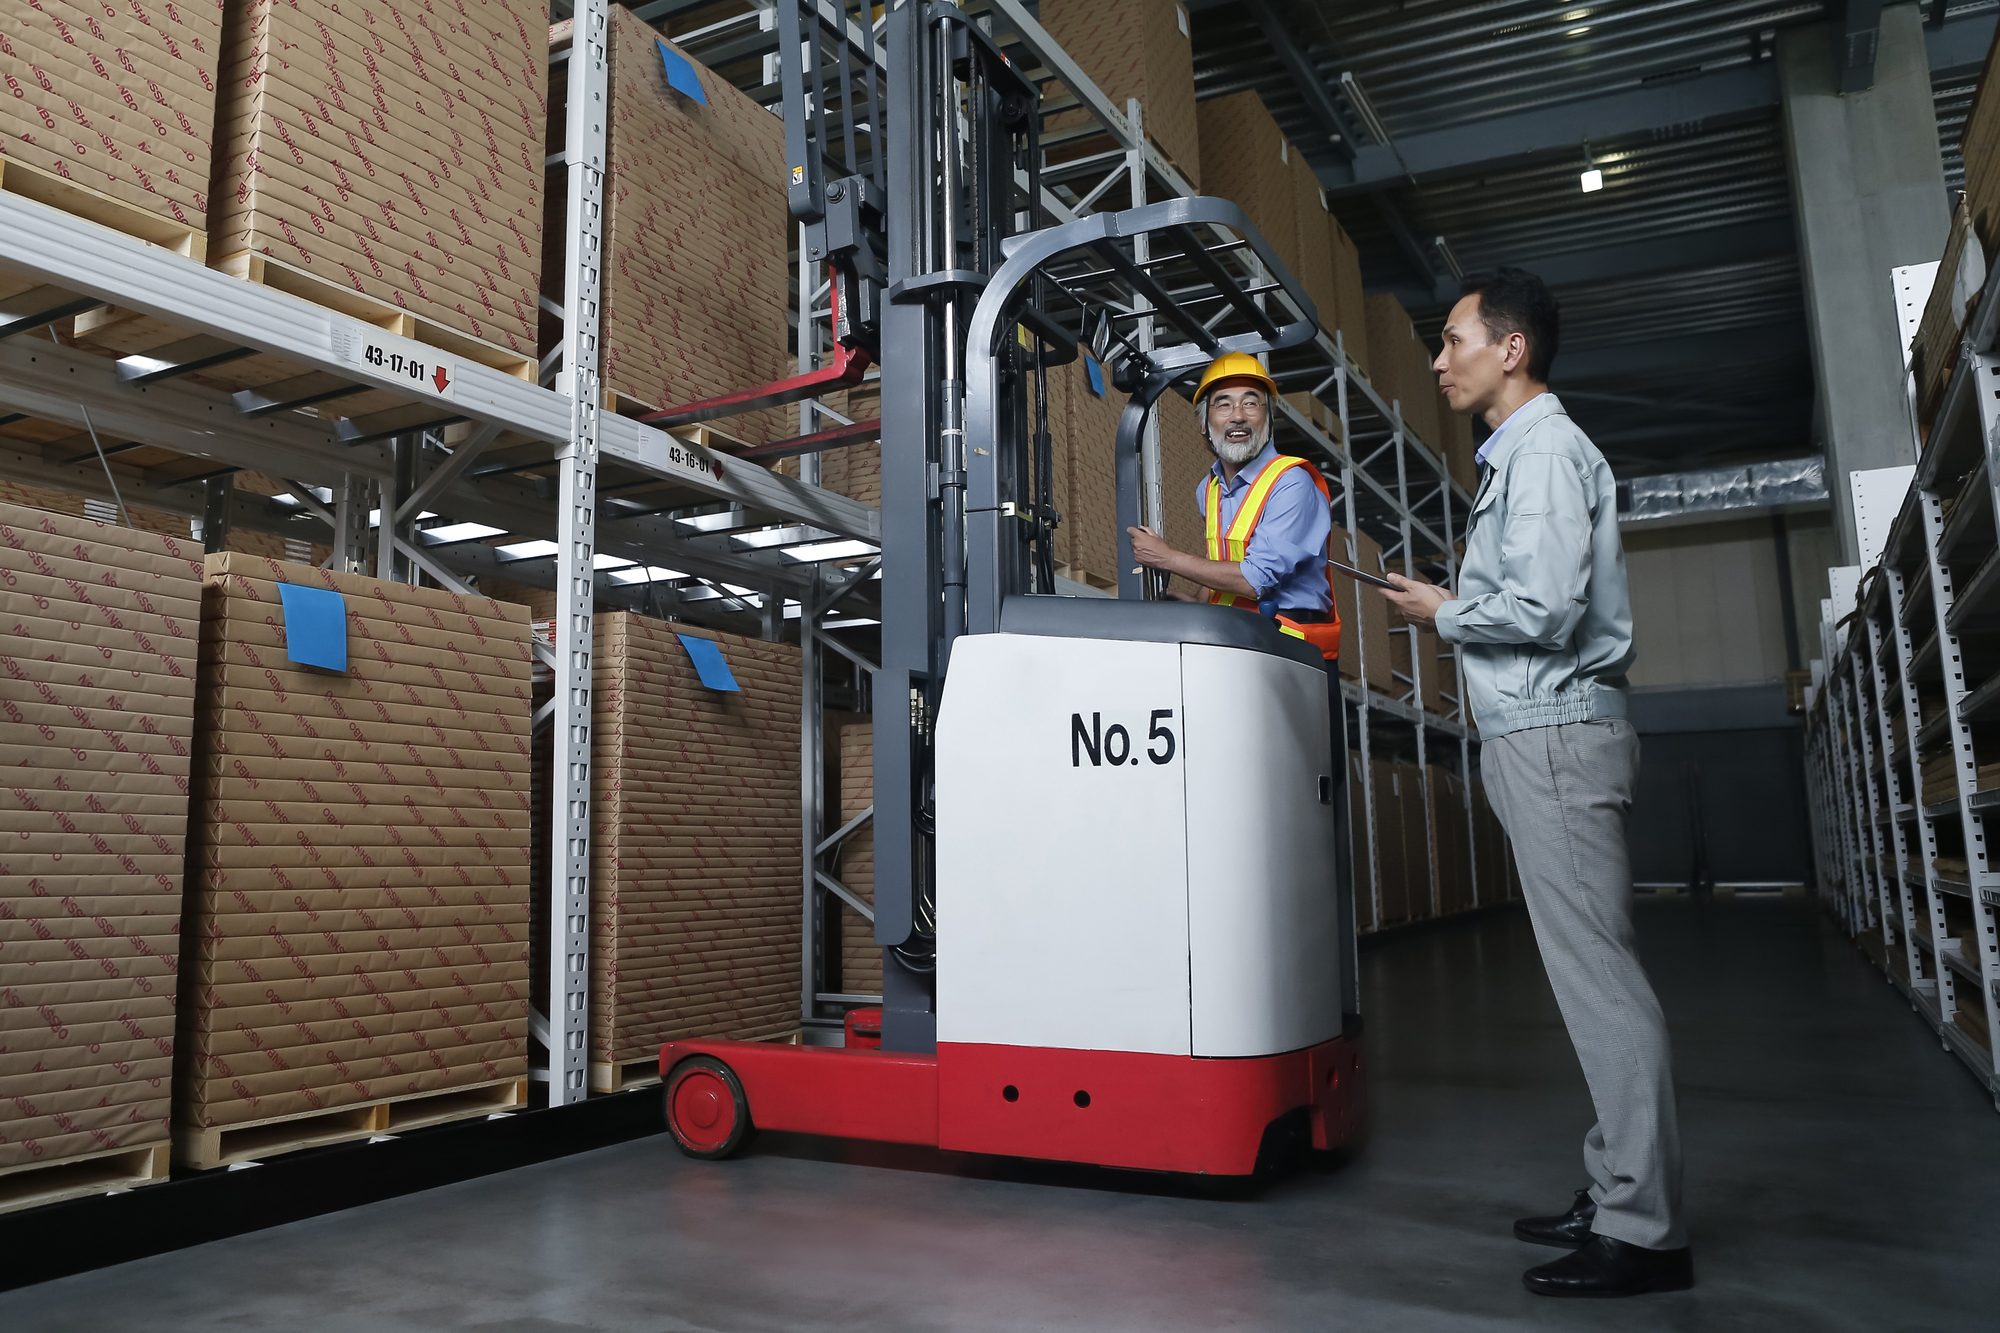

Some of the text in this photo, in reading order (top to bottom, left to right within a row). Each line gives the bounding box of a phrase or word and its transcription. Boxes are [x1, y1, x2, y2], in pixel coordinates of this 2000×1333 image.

[365, 345, 424, 381] 43-17-01
[669, 447, 709, 473] 43-16-01
[1072, 708, 1175, 767] No. 5
